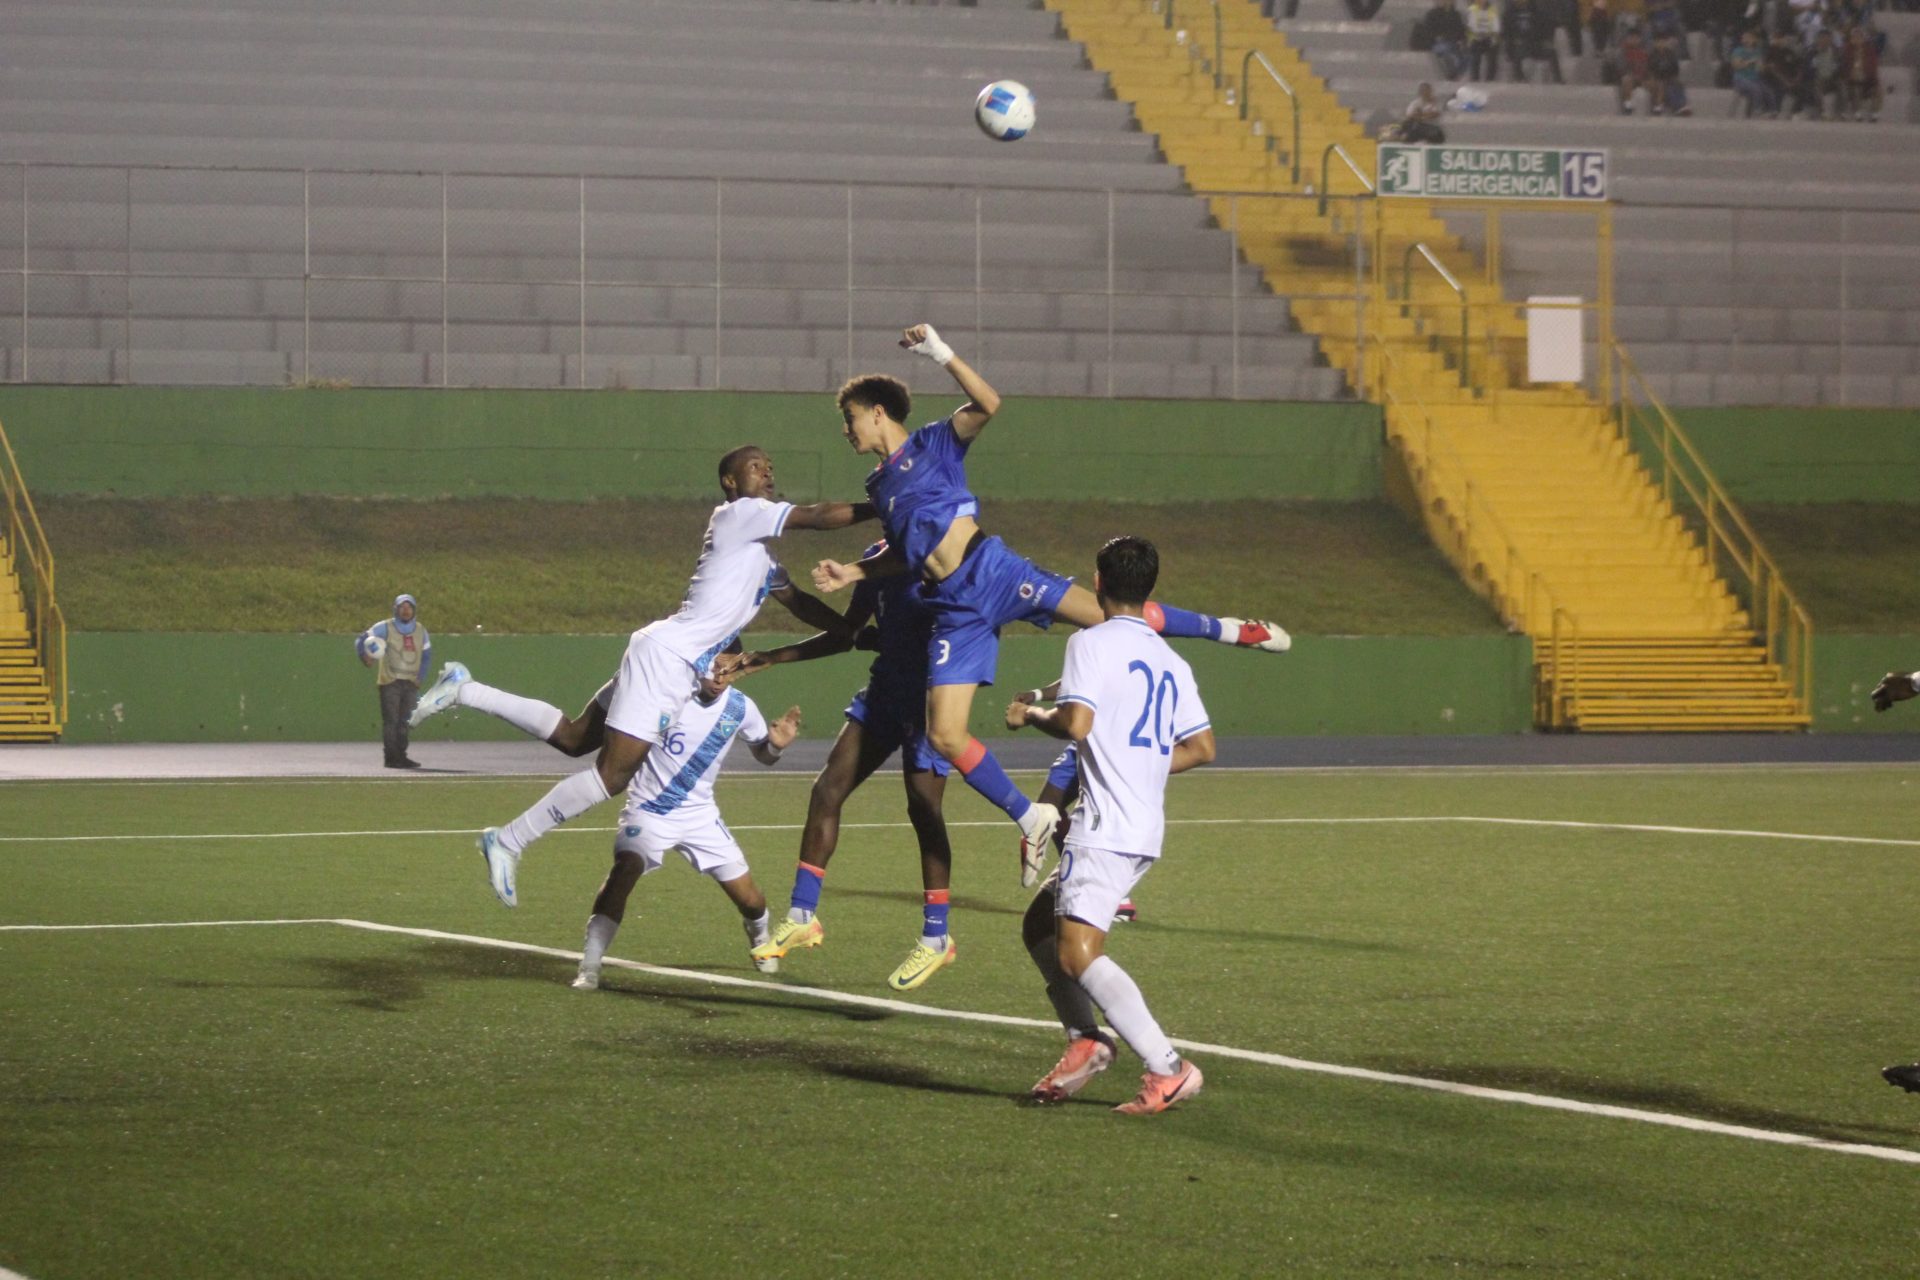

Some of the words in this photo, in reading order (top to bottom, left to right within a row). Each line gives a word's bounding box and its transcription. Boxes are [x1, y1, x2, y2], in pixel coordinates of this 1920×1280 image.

[1440, 151, 1512, 172] SALIDA
[1517, 153, 1545, 172] DE
[1427, 173, 1558, 195] EMERGENCIA
[1564, 154, 1603, 196] 15
[936, 639, 950, 665] 3
[1128, 659, 1179, 755] 20
